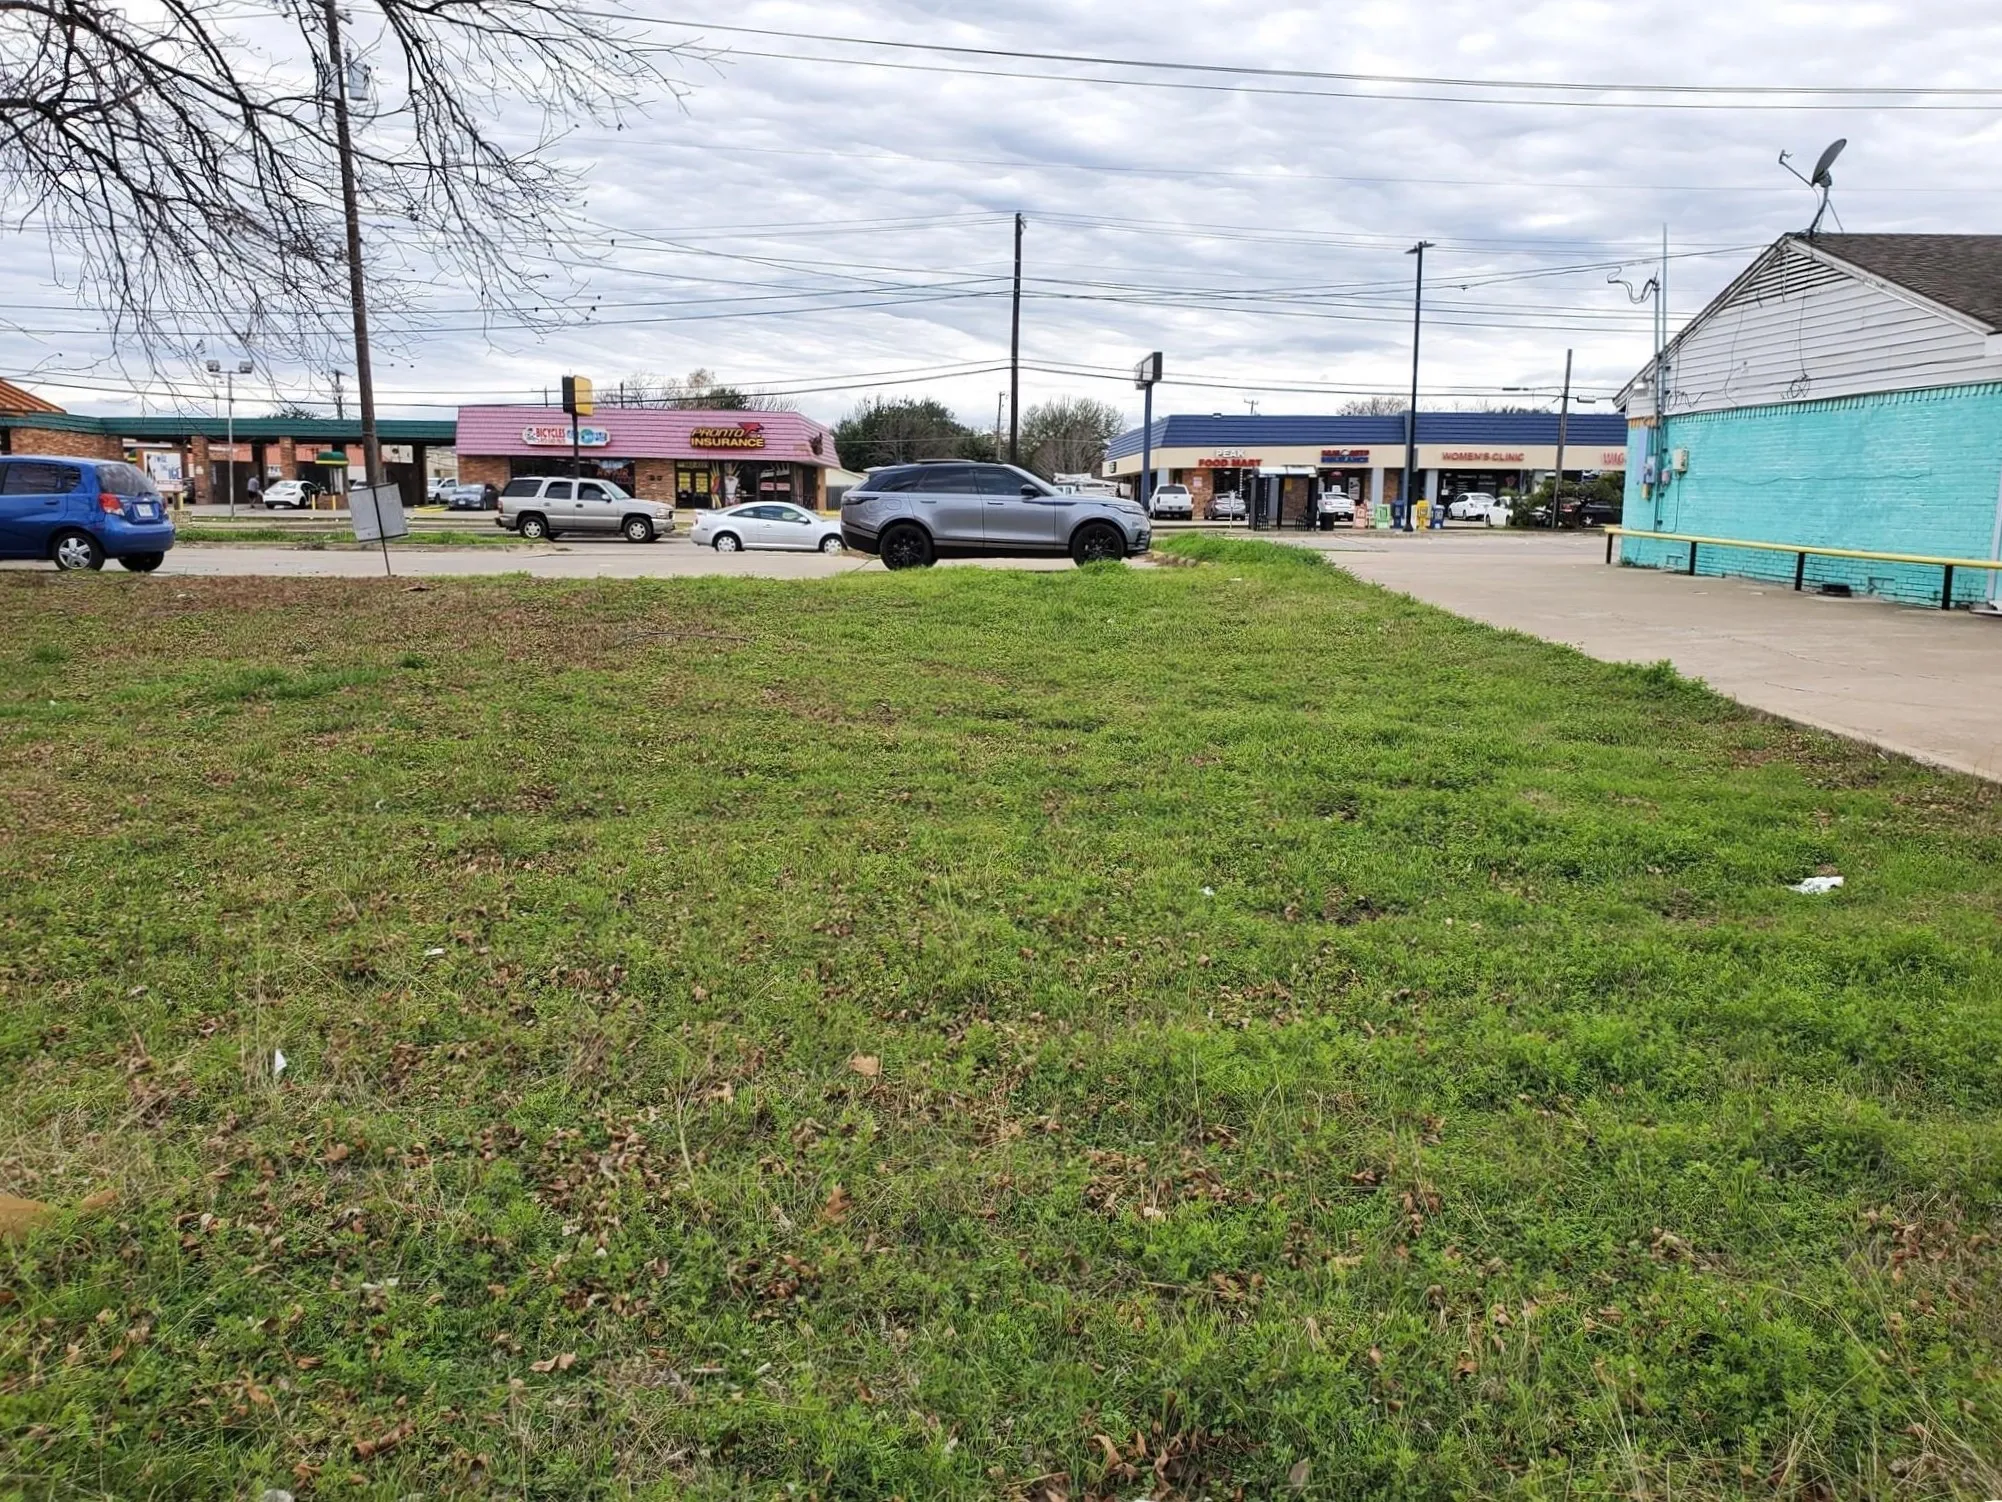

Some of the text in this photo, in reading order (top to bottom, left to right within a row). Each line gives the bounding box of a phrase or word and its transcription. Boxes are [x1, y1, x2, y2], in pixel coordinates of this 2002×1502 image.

[536, 427, 566, 438] BICYCLES
[691, 428, 745, 437] PRONTO
[691, 437, 764, 447] INSURANCE
[1216, 449, 1245, 457] PEAK
[1442, 452, 1525, 462] WOMEN'S CLINIC
[1198, 459, 1262, 467] FOOD MART
